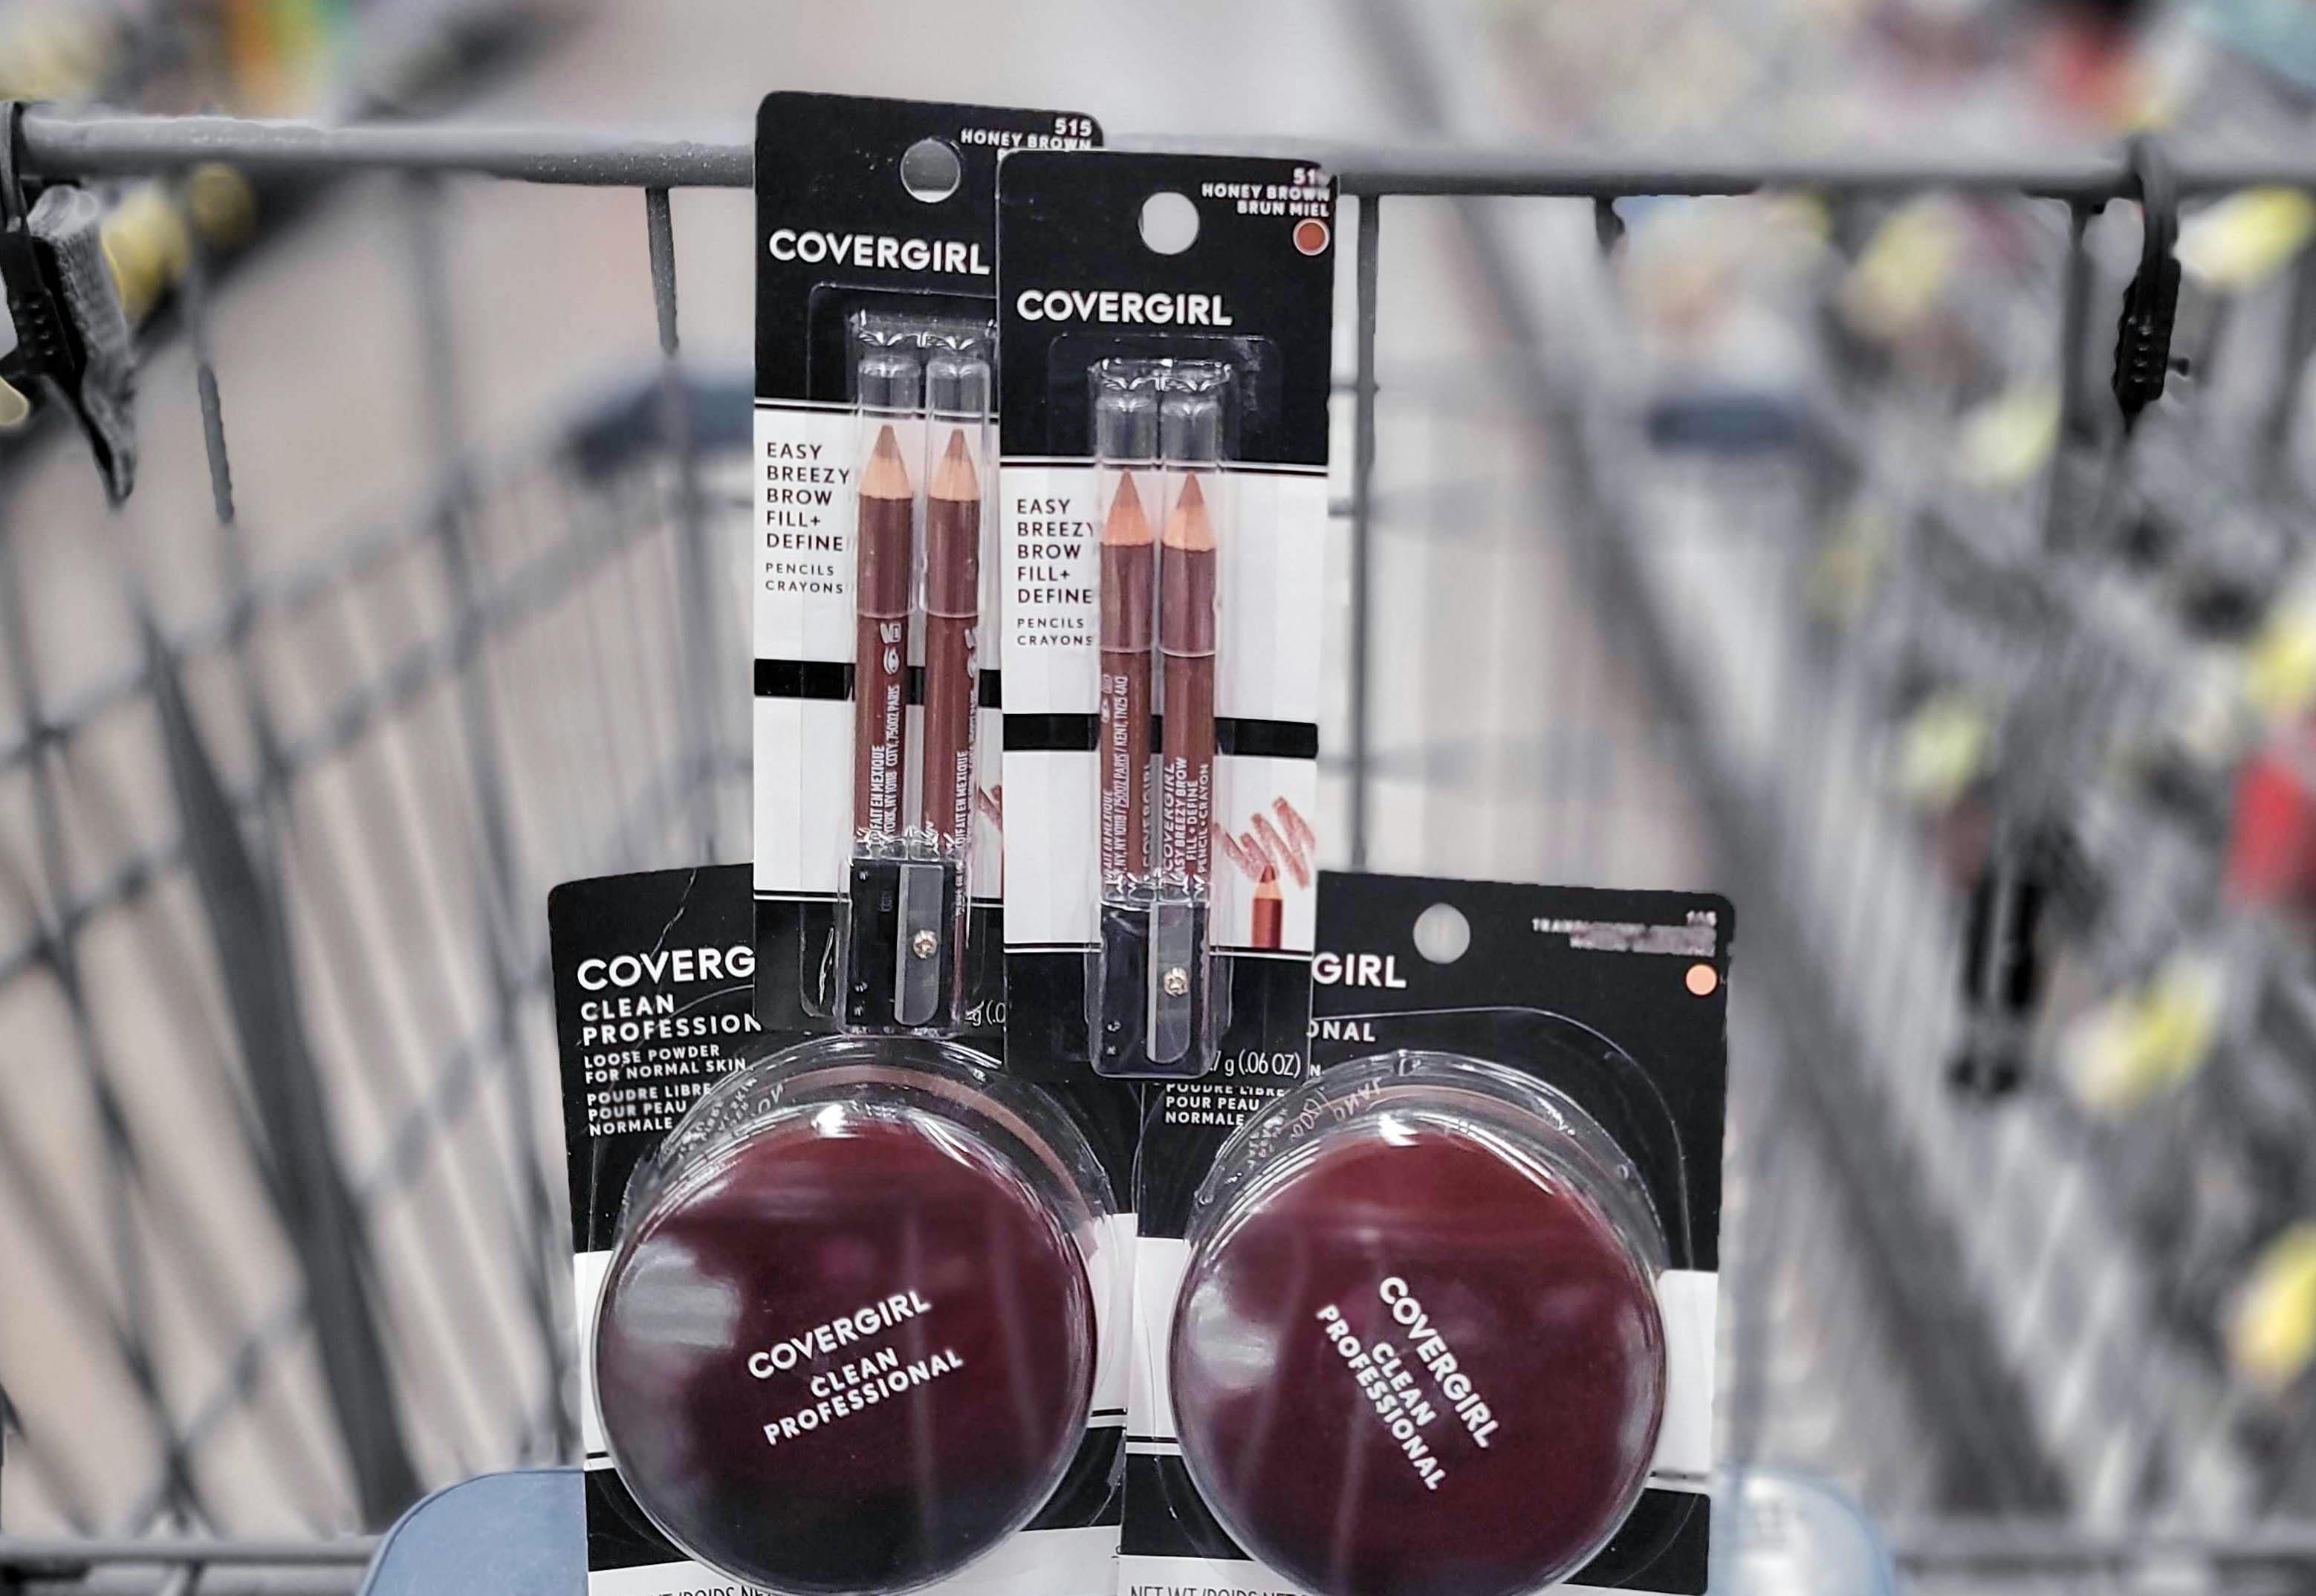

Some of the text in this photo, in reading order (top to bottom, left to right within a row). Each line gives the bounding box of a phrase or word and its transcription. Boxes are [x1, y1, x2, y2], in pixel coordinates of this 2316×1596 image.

[961, 128, 1092, 150] HONEY BROWN
[1054, 117, 1092, 137] 515
[1293, 167, 1326, 186] 51
[1201, 183, 1331, 202] HONEY BROWN
[1237, 199, 1329, 218] BRUN MIEL
[768, 228, 991, 276] COVERGIRL
[1016, 289, 1233, 327] COVERGIRL
[767, 442, 823, 461] EASY
[766, 464, 850, 484] BREEZY
[766, 487, 833, 506] BROW
[1017, 499, 1071, 514] EASY
[766, 510, 821, 528] FILL+
[766, 533, 844, 552] DEFINE
[1017, 544, 1081, 559] BROW
[765, 562, 835, 577] PENCILS
[1017, 565, 1071, 582] FILL+
[765, 580, 844, 594] CRAYONS
[1017, 588, 1093, 604] DEFINE
[1016, 617, 1085, 629] PENCILS
[1016, 635, 1094, 646] CRAYONS
[887, 684, 900, 711] PARIS
[870, 745, 884, 792] MEXIQUE
[956, 750, 968, 797] MEXIQUE
[1112, 753, 1128, 779] PARIS
[870, 794, 883, 808] EN
[1113, 781, 1128, 808] 75002
[1187, 780, 1198, 824] DEFINE
[1198, 763, 1209, 819] CRAYON
[956, 798, 967, 811] EN
[1103, 789, 1113, 837] MEXIQUE
[1163, 762, 1175, 871] COVERGIRL
[1175, 756, 1187, 877] ASY BREEZY BROW
[1113, 837, 1126, 851] NY
[1187, 836, 1197, 860] FILL
[577, 945, 755, 990] COVERG
[1311, 952, 1407, 988] GIRL
[580, 993, 674, 1022] CLEAN
[583, 1013, 762, 1046] PROFESSION
[584, 1044, 721, 1069] LOOSE POWDER
[1271, 1052, 1301, 1078] OZ)
[585, 1057, 747, 1084] FOR NORMAL SKIN
[586, 1082, 712, 1106] POUDRE LIBRE
[1165, 1096, 1260, 1112] POUR PEAU
[588, 1100, 687, 1122] POUR PEAU
[1165, 1111, 1245, 1126] NORMALE
[588, 1117, 674, 1137] NORMALE
[747, 1291, 932, 1379] COVERGIRL
[810, 1347, 899, 1398] CLEAN
[1379, 1277, 1499, 1449] COVERGIRL
[1372, 1343, 1436, 1426] CLEAN
[763, 1349, 964, 1445] PROFESSIONAL
[1316, 1305, 1446, 1490] PROFESSIONAL
